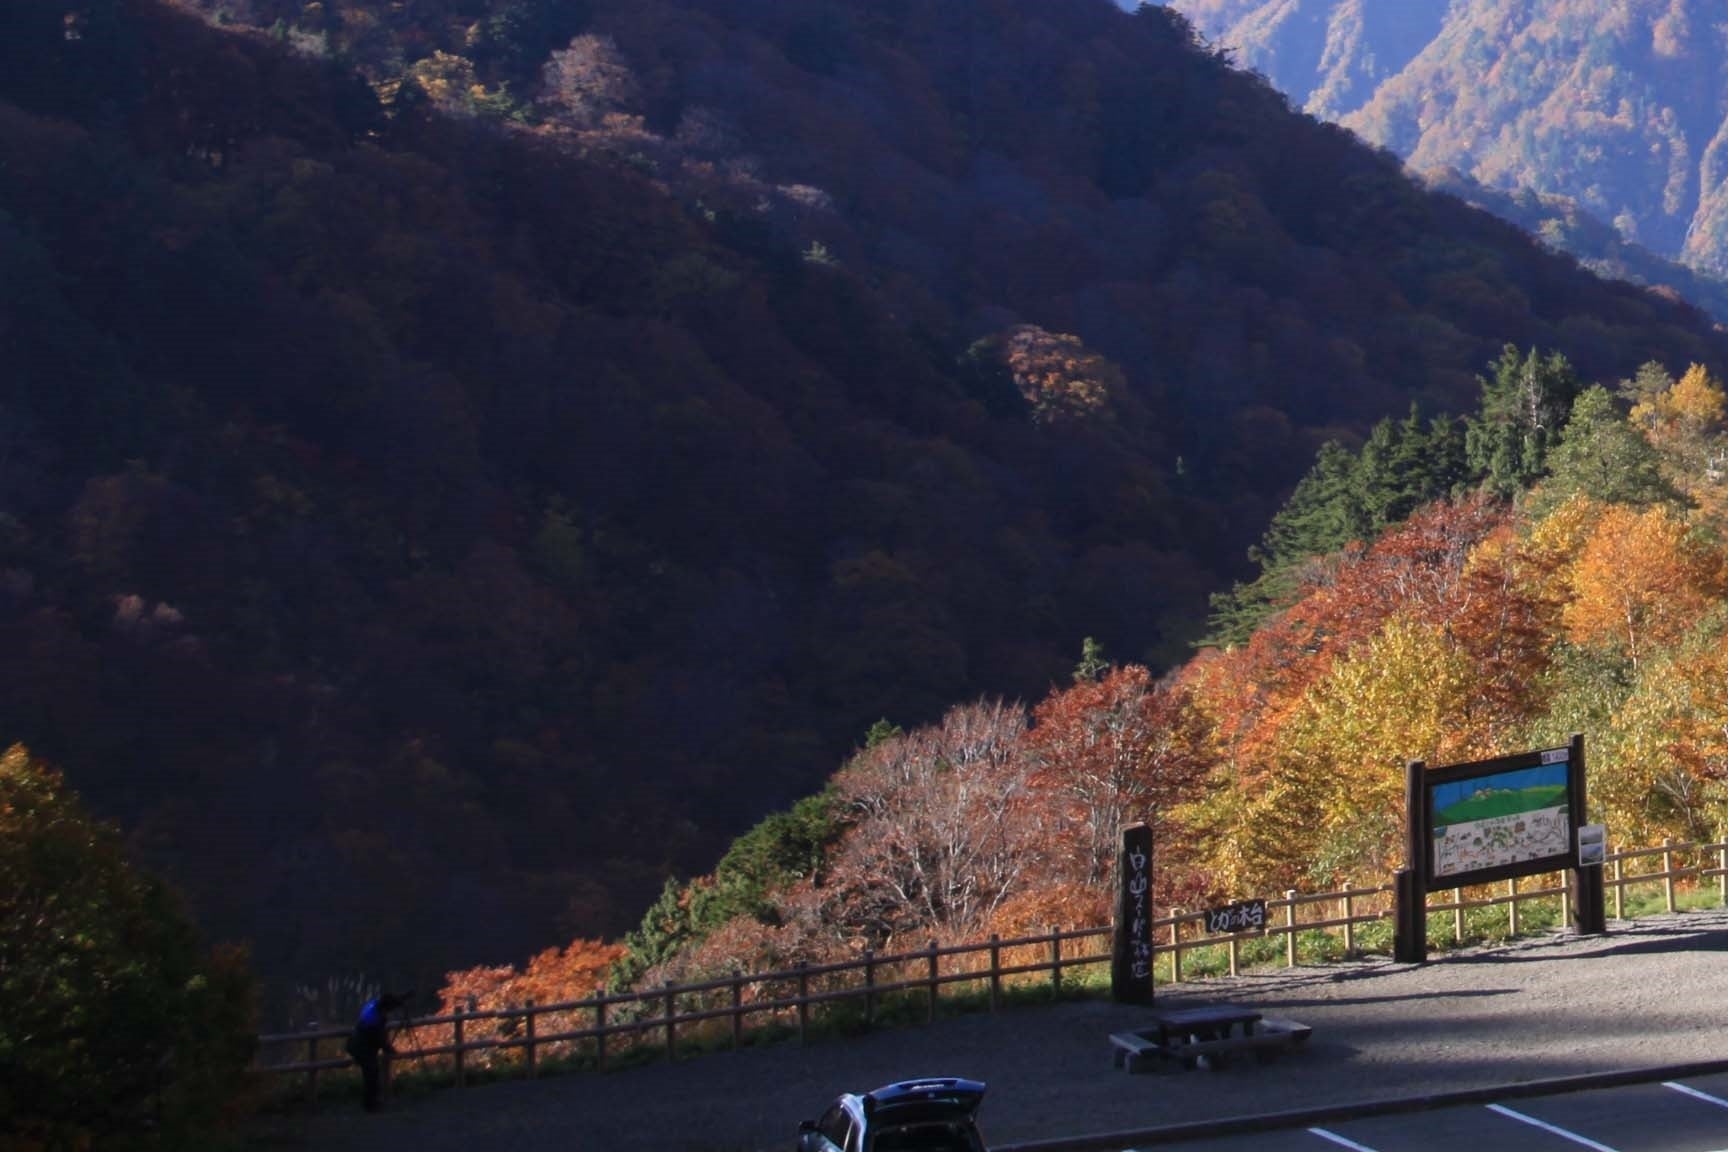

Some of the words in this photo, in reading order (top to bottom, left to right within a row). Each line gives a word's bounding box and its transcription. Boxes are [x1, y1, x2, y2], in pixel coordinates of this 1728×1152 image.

[1209, 902, 1264, 932] とがの木台
